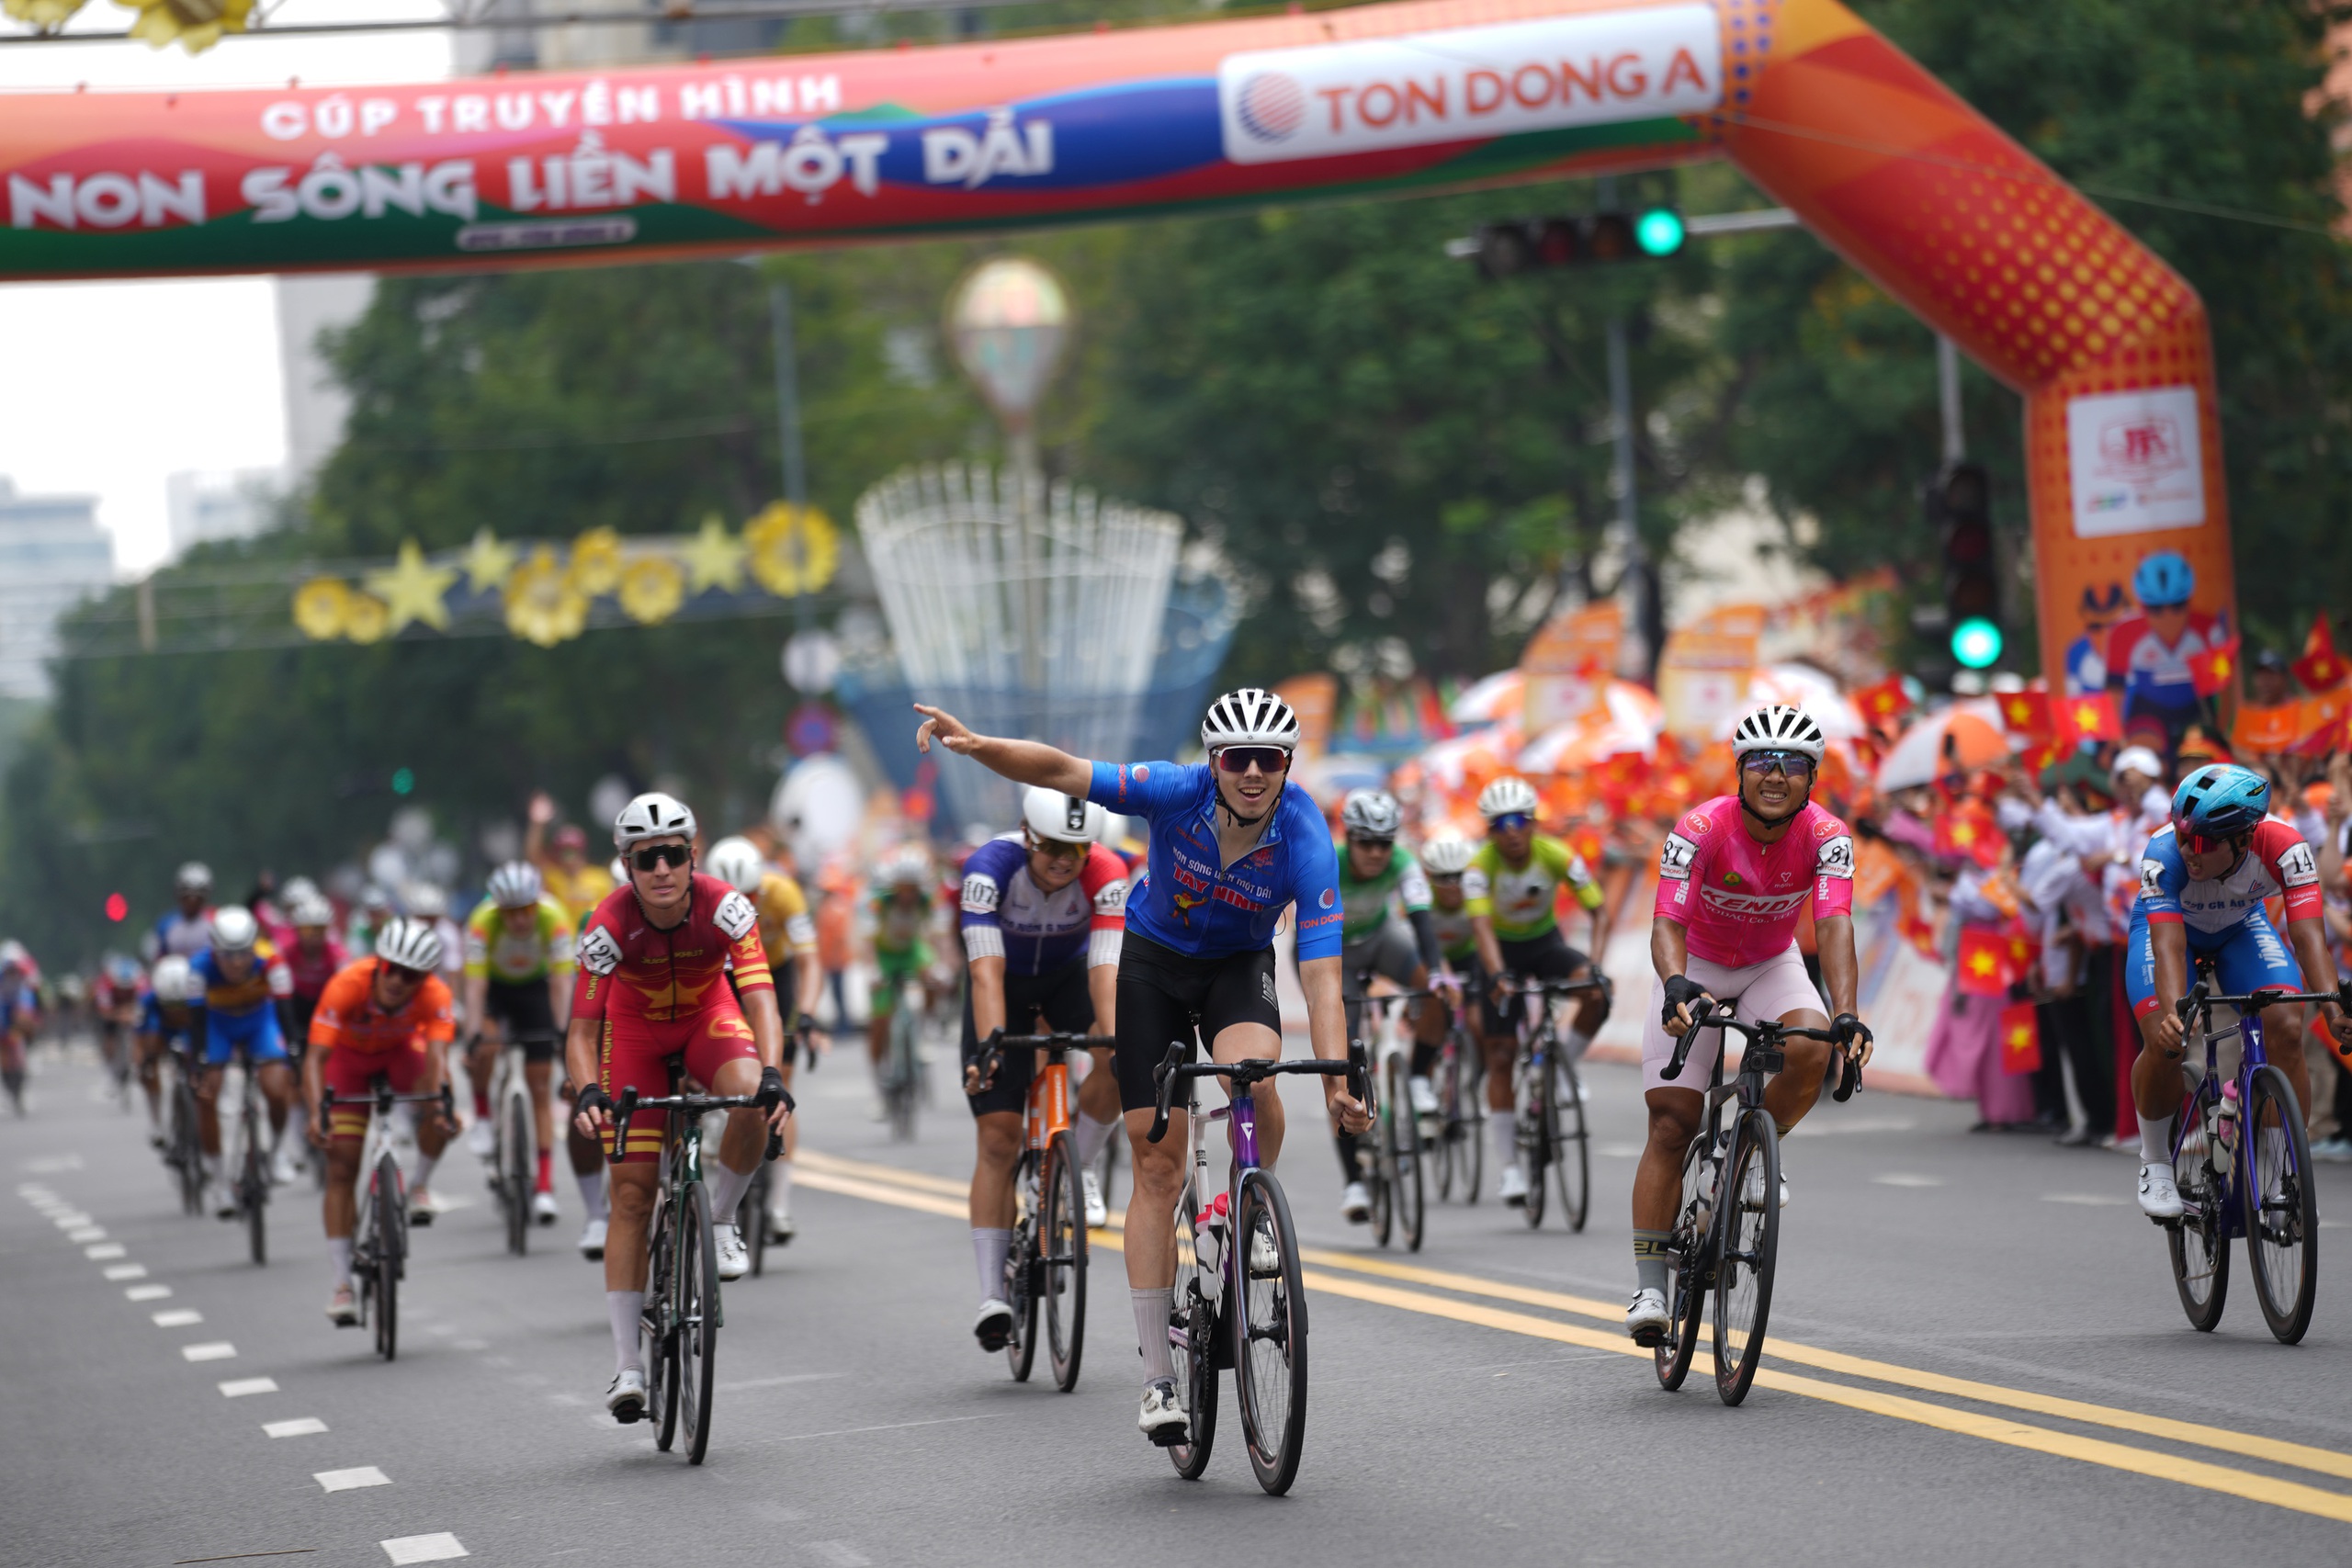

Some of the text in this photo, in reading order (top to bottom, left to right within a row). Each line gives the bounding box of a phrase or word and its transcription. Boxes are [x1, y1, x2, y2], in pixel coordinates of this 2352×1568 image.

[1317, 47, 1707, 133] TON DONG A
[261, 93, 397, 140] CÚP
[680, 73, 841, 120] HÌNH
[7, 170, 207, 229] NON
[241, 152, 476, 221] SÔNG
[705, 124, 889, 205] MỘT
[1690, 814, 1708, 833] VDC
[1816, 820, 1838, 836] VDC
[1661, 840, 1683, 866] 81
[1827, 844, 1849, 866] 81
[2293, 849, 2313, 874] 14
[1173, 862, 1264, 911] TÂY NINH
[1188, 859, 1212, 876] SÔNG
[1256, 886, 1272, 899] DẢI
[965, 881, 995, 904] 107
[1702, 890, 1805, 912] KENDA
[2293, 891, 2318, 899] Logistics
[721, 896, 752, 931] 127
[1299, 918, 1318, 930] TON
[1704, 903, 1746, 922] VODAC
[584, 931, 618, 971] 127
